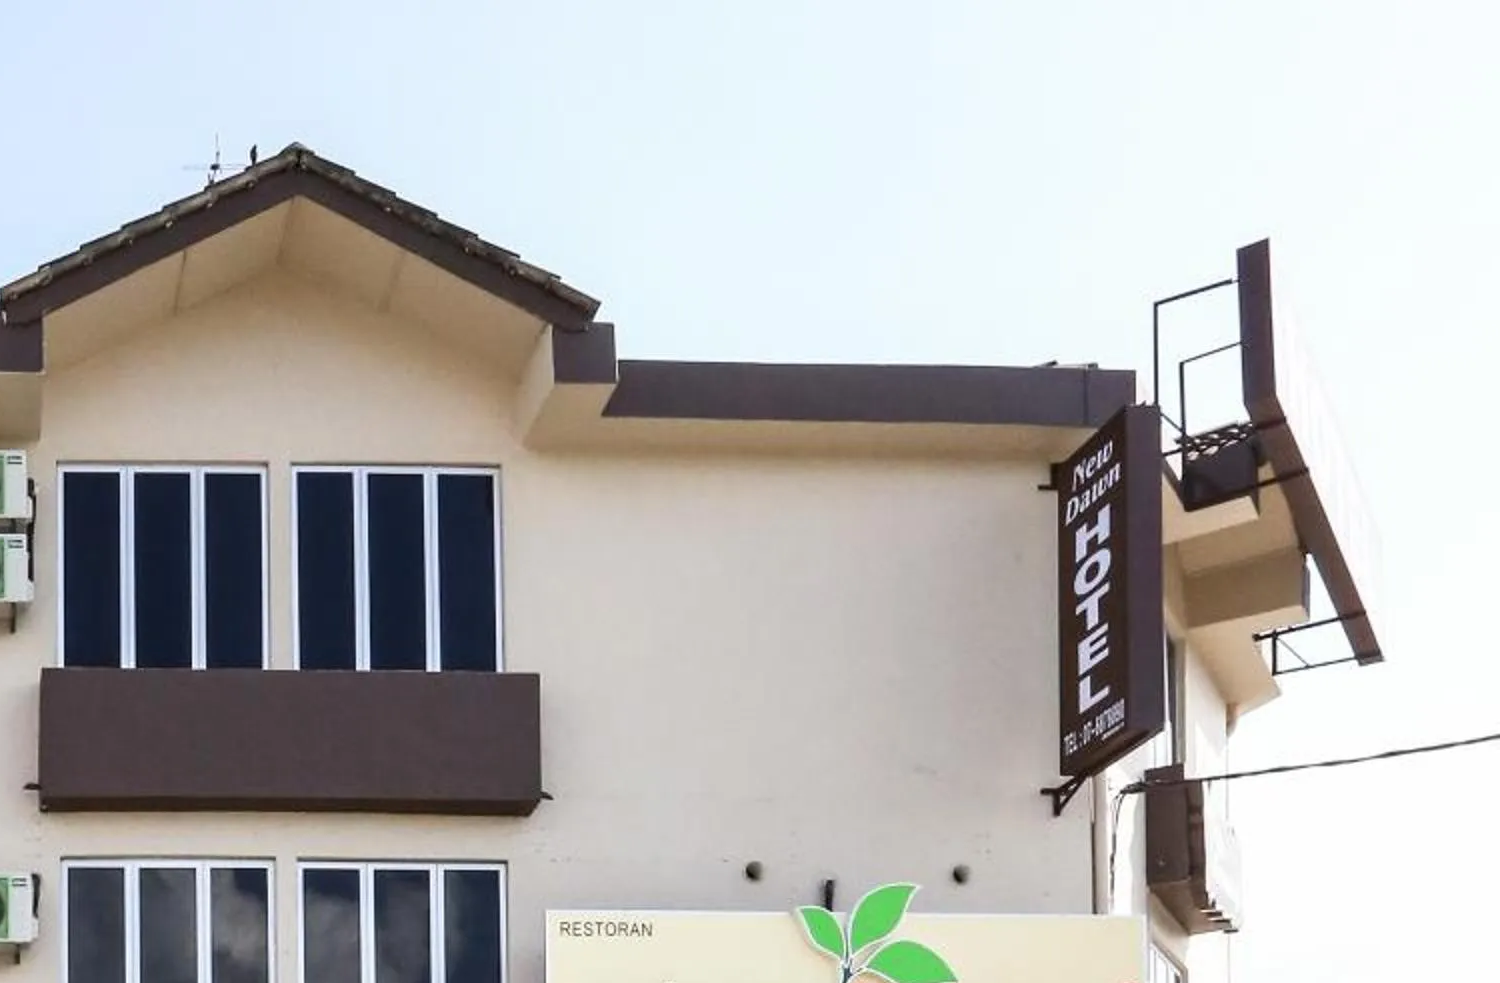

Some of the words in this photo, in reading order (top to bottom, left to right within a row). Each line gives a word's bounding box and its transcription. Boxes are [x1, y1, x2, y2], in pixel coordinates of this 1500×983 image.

[1071, 440, 1113, 489] New
[1065, 462, 1121, 527] Dawn
[1073, 504, 1111, 715] HOTEL
[559, 921, 653, 938] RESTORAN
